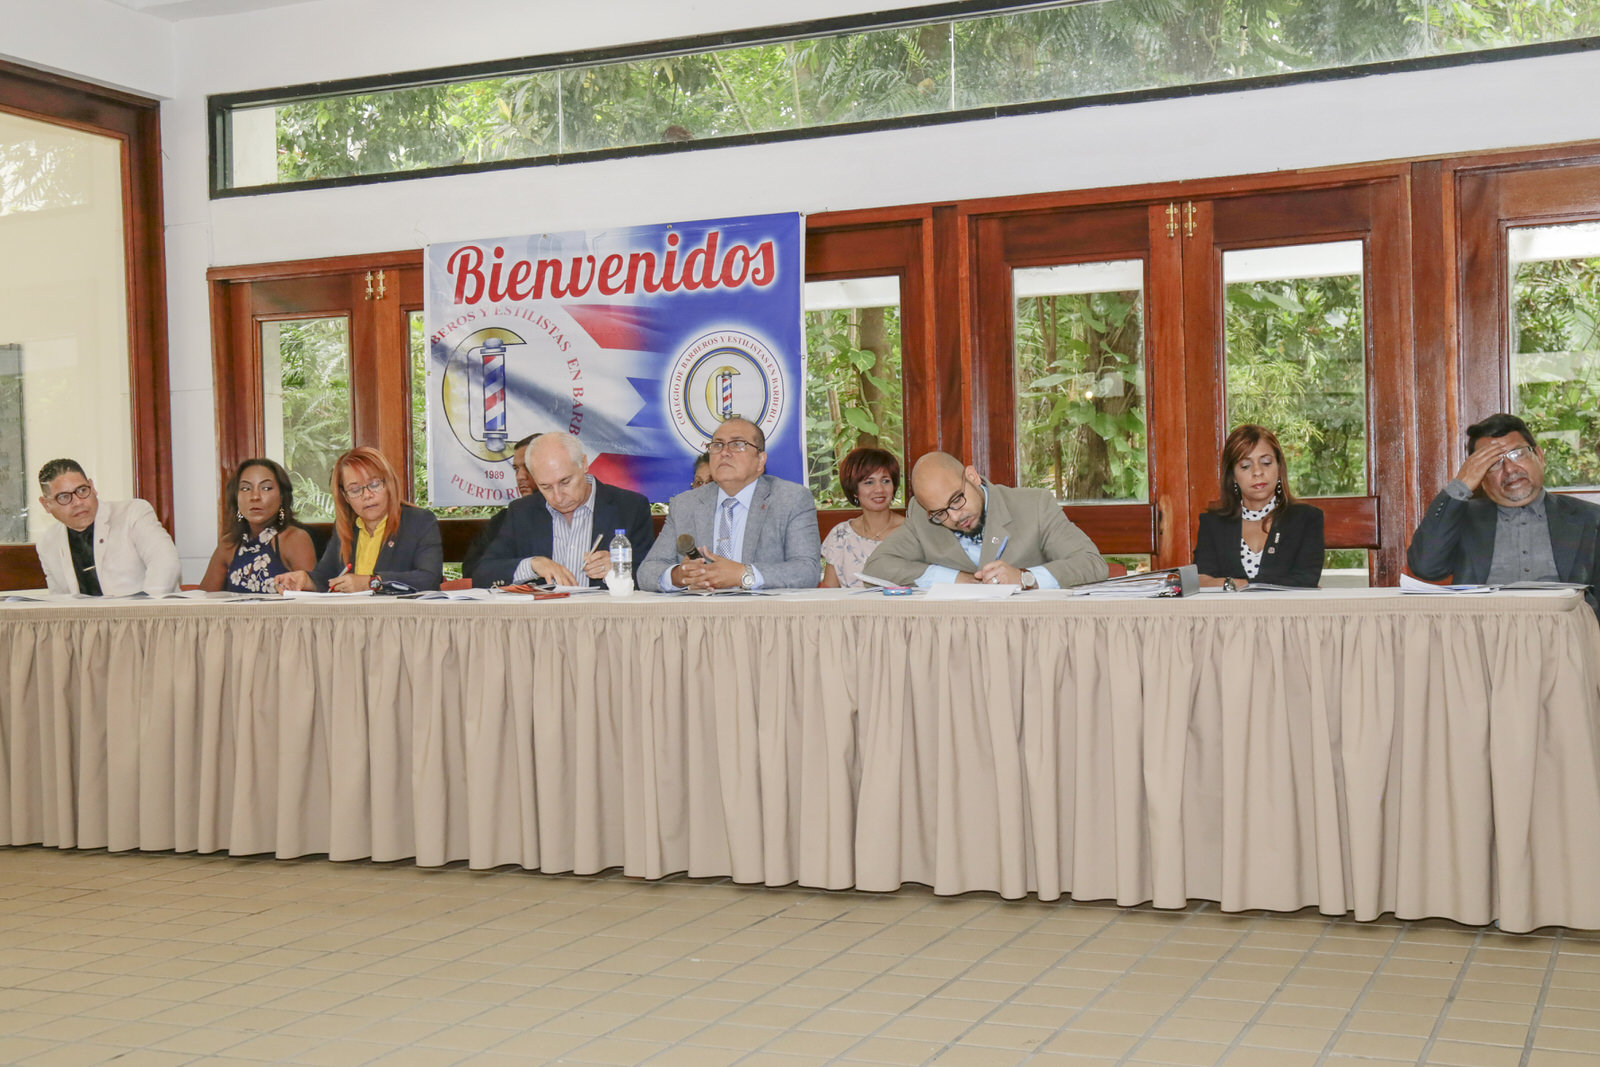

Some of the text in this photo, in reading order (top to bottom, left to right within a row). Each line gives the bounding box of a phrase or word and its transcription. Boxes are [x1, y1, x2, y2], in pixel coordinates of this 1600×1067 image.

[447, 231, 776, 305] Bienvenidos
[480, 308, 487, 318] Y
[494, 305, 572, 352] ESTILISTAS
[567, 357, 583, 380] EN
[681, 337, 718, 369] BARBEROS
[727, 335, 769, 364] ESTILISTAS
[676, 371, 684, 383] DE
[767, 363, 776, 376] EN
[673, 384, 686, 425] COLEGIO
[450, 473, 503, 501] PUERTO
[484, 470, 505, 480] 1989
